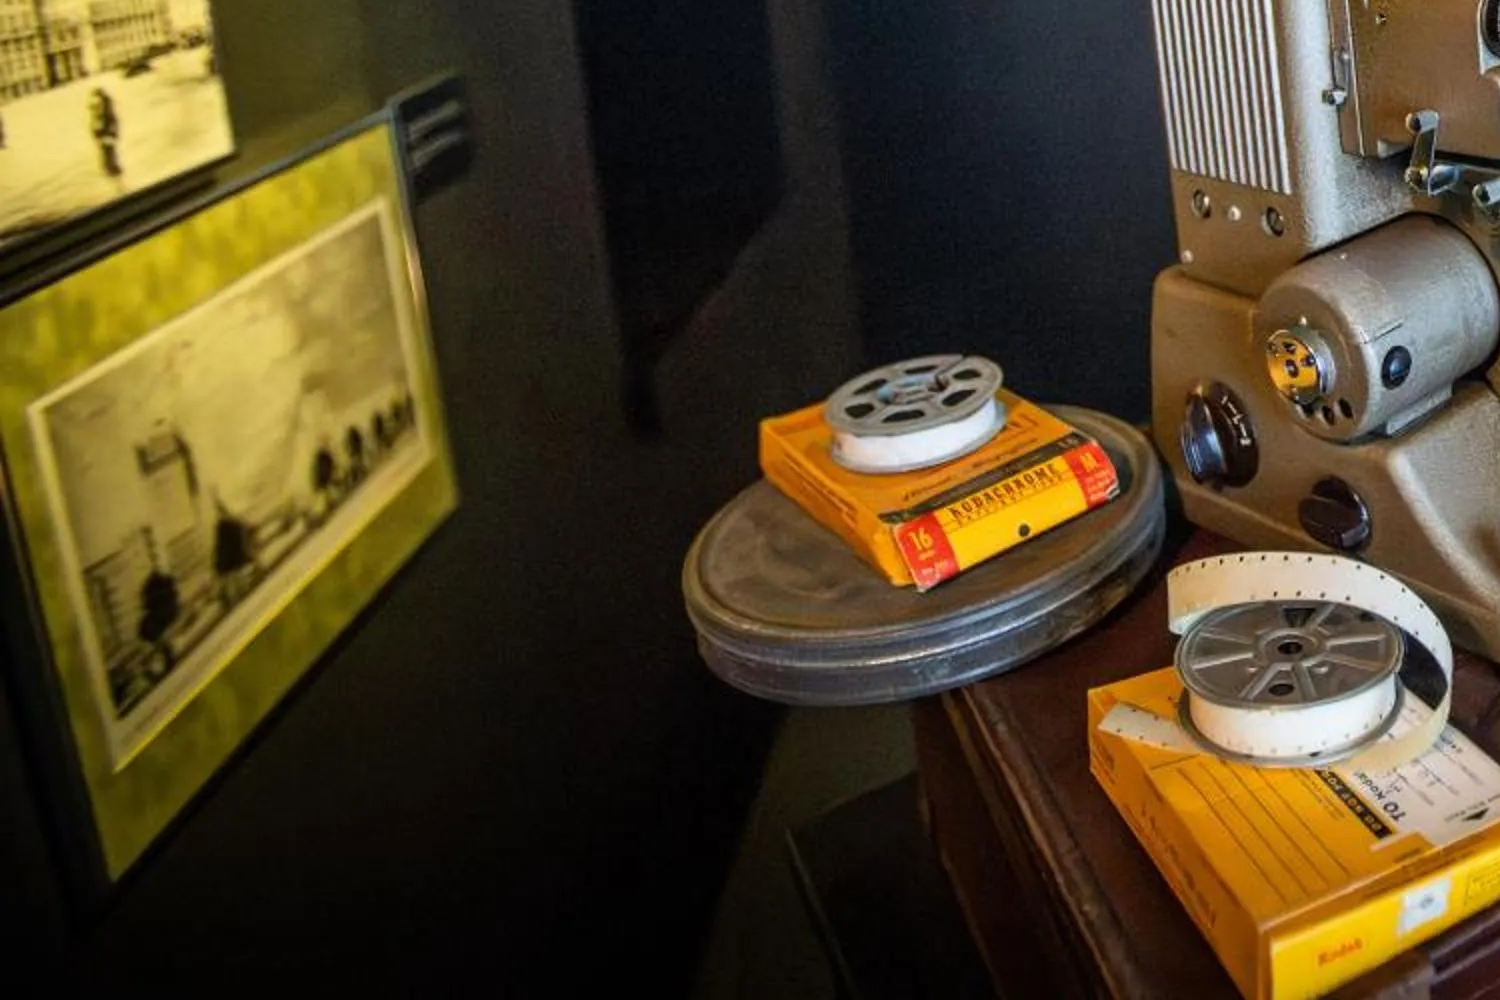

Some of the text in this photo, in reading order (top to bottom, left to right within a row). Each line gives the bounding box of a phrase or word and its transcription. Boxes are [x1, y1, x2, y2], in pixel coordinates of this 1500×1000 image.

[949, 463, 1058, 519] KODACHROME
[908, 526, 934, 551] 16
[1383, 800, 1406, 822] TO
